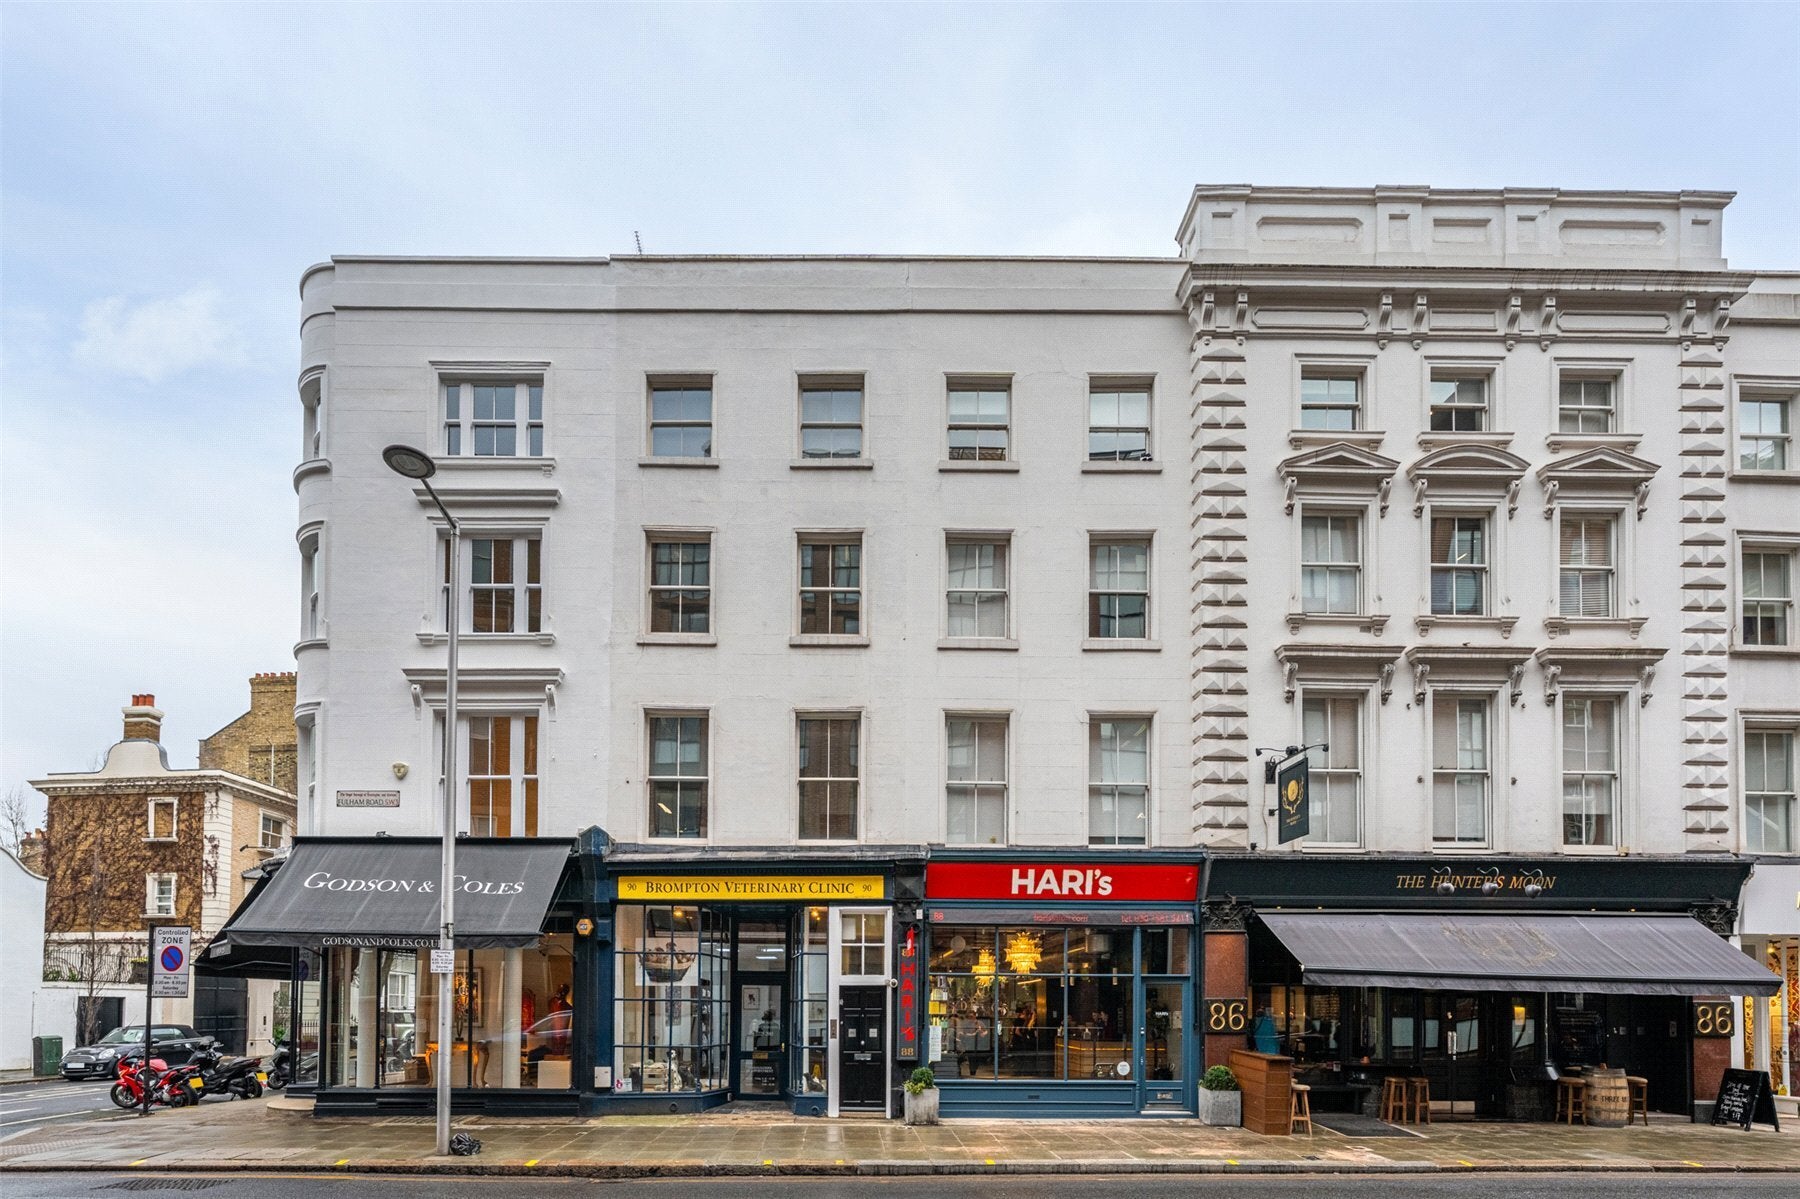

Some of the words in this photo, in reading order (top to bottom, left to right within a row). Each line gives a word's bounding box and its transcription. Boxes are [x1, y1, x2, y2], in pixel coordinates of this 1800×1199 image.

[417, 880, 435, 893] &
[627, 883, 637, 891] 90
[645, 881, 720, 894] BROMPTON
[724, 881, 805, 894] VETERINARY
[808, 881, 855, 894] CLINIC
[862, 883, 873, 892] 90
[1010, 868, 1113, 896] HARI's
[1396, 875, 1426, 889] THE
[1509, 875, 1557, 889] MOON
[161, 936, 184, 944] ZONE
[1210, 1002, 1245, 1030] 86
[1696, 1005, 1732, 1034] 86
[901, 1047, 914, 1056] 88
